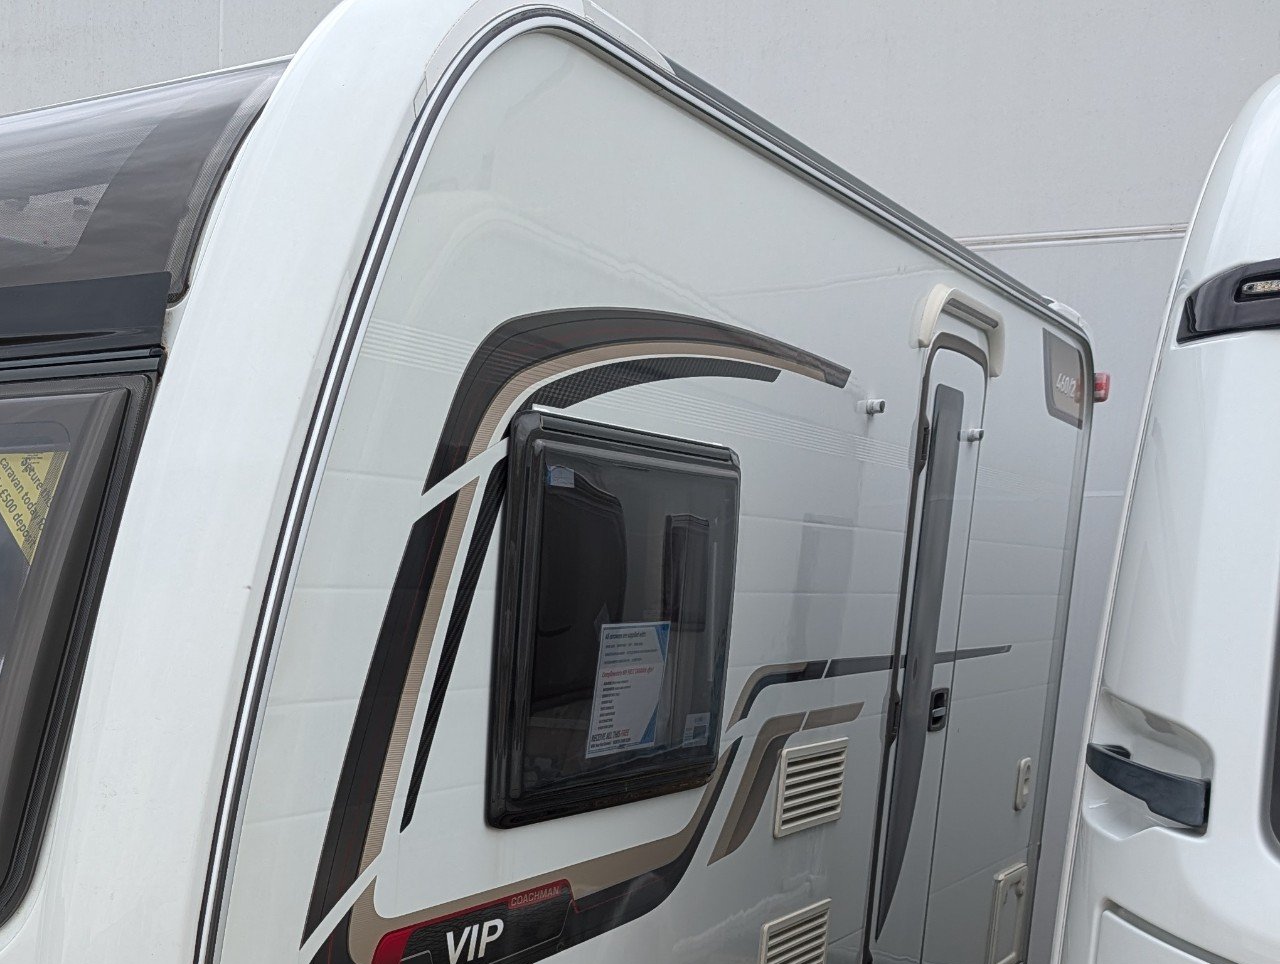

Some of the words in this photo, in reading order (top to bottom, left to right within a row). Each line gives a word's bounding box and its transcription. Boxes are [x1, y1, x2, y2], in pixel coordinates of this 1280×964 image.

[0, 458, 24, 494] caravan
[20, 458, 43, 490] Secure
[0, 489, 18, 514] £500
[510, 886, 560, 906] COACHMAN
